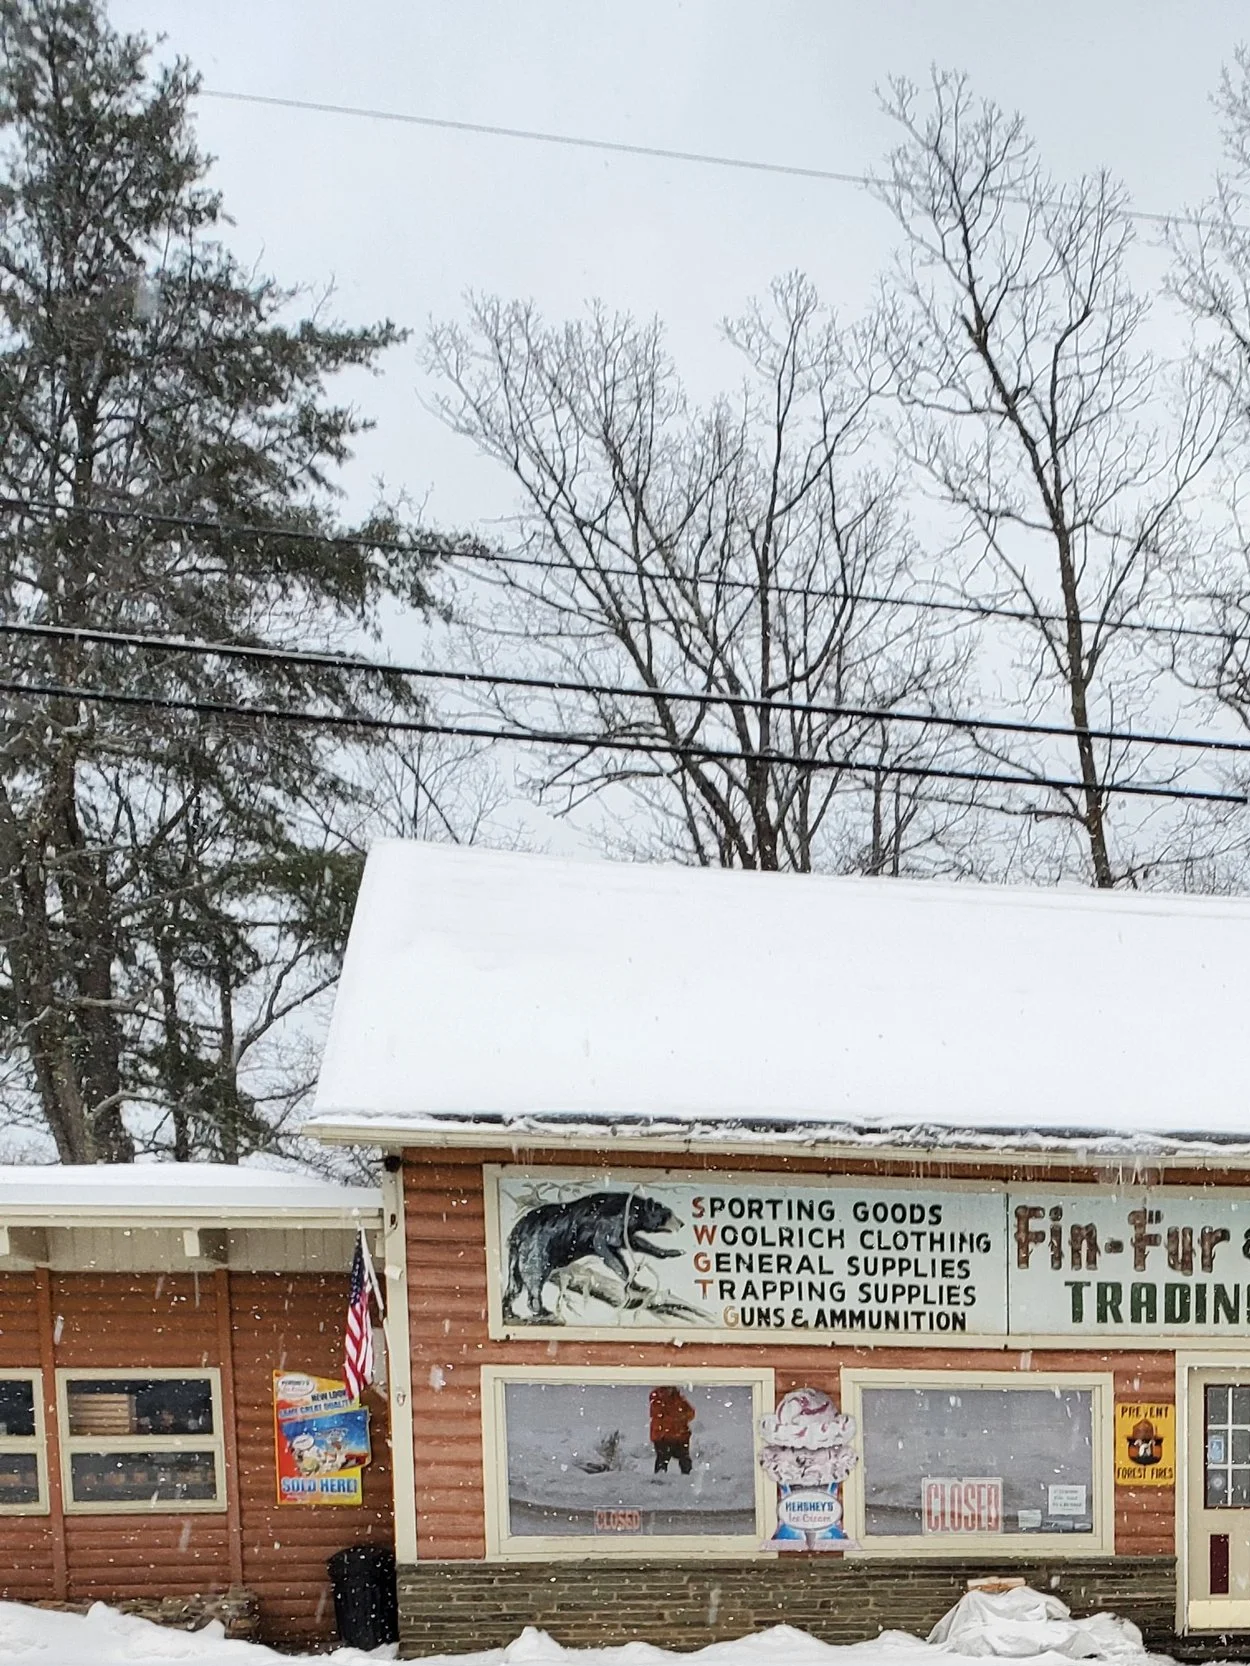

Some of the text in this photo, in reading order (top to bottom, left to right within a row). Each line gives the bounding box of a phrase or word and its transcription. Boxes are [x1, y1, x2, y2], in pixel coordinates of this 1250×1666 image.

[691, 1196, 943, 1225] SPORTING GOODS
[694, 1224, 992, 1255] WOOLRICH CLOTHING
[1014, 1204, 1230, 1277] Fin-Fur
[693, 1252, 972, 1280] GENERAL SUPPLIES
[695, 1279, 977, 1306] TRAPPING SUPPLIES
[723, 1306, 967, 1331] GUNS & AMMUNITION
[1121, 1405, 1168, 1418] PREVENT
[282, 1478, 317, 1493] SOLD
[1117, 1466, 1174, 1480] FOREST FIRES
[597, 1510, 640, 1530] CLOSED
[926, 1483, 1000, 1532] CLOSED
